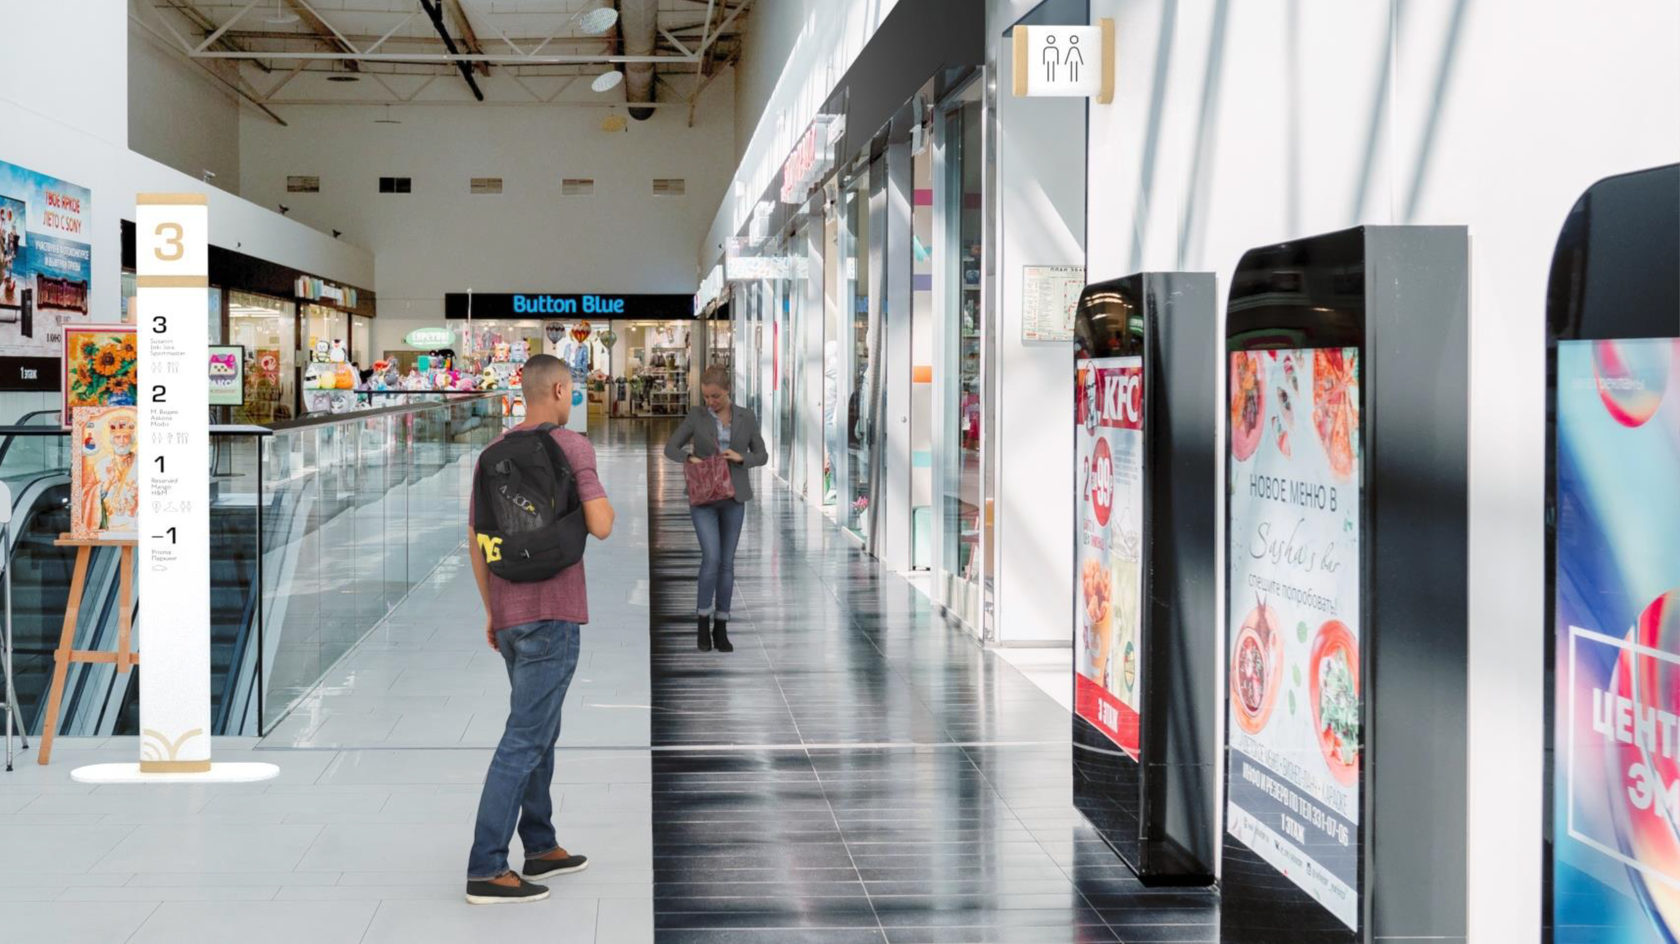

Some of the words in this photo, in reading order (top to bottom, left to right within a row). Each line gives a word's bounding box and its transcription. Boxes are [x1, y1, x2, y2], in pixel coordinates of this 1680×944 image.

[45, 190, 60, 208] ТВОЕ
[62, 194, 80, 214] ЯРКОЕ
[43, 210, 59, 228] ЛЕТО
[66, 215, 81, 234] SONY
[154, 222, 184, 261] 3
[513, 295, 577, 313] Button
[582, 295, 625, 313] Blue
[152, 315, 167, 334] 3
[152, 385, 166, 403] 2
[1103, 374, 1139, 423] KFC
[154, 455, 164, 473] 1
[1083, 455, 1090, 502] 2
[1097, 456, 1110, 508] 99
[1250, 474, 1286, 503] НОВОЕ
[1290, 479, 1326, 510] МЕНЮ
[1329, 486, 1338, 512] В
[1248, 573, 1281, 597] спешите
[1593, 687, 1680, 763] ЦЕНТ
[1285, 814, 1304, 845] ЭТАЖ
